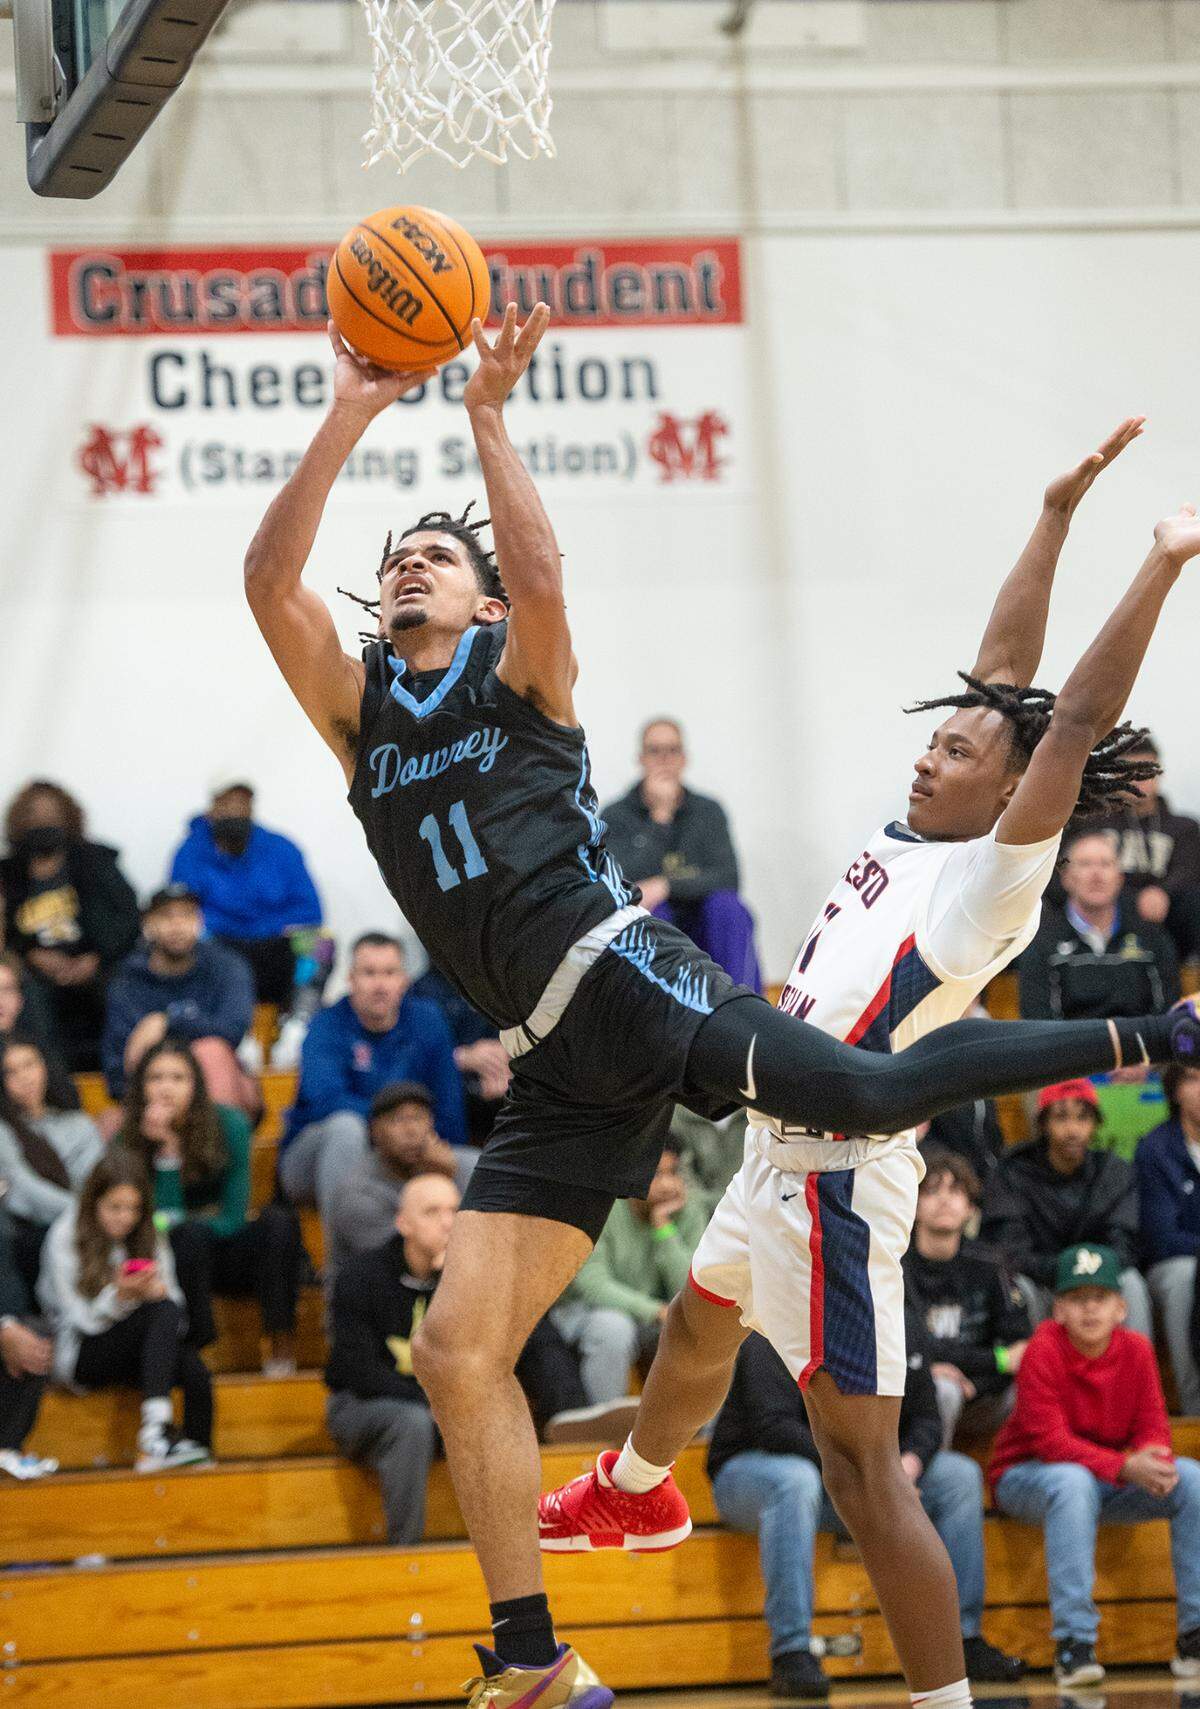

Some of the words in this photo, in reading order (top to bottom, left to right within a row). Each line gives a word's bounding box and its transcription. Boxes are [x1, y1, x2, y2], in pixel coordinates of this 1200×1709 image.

[76, 256, 329, 323] Crusad
[490, 253, 721, 318] tudent
[351, 234, 423, 326] Wilson
[148, 349, 332, 411] Chee
[396, 344, 660, 404] etion
[179, 440, 421, 490] (Staning
[438, 431, 638, 481] Stion)
[369, 727, 509, 799] Downey
[418, 800, 489, 893] 11
